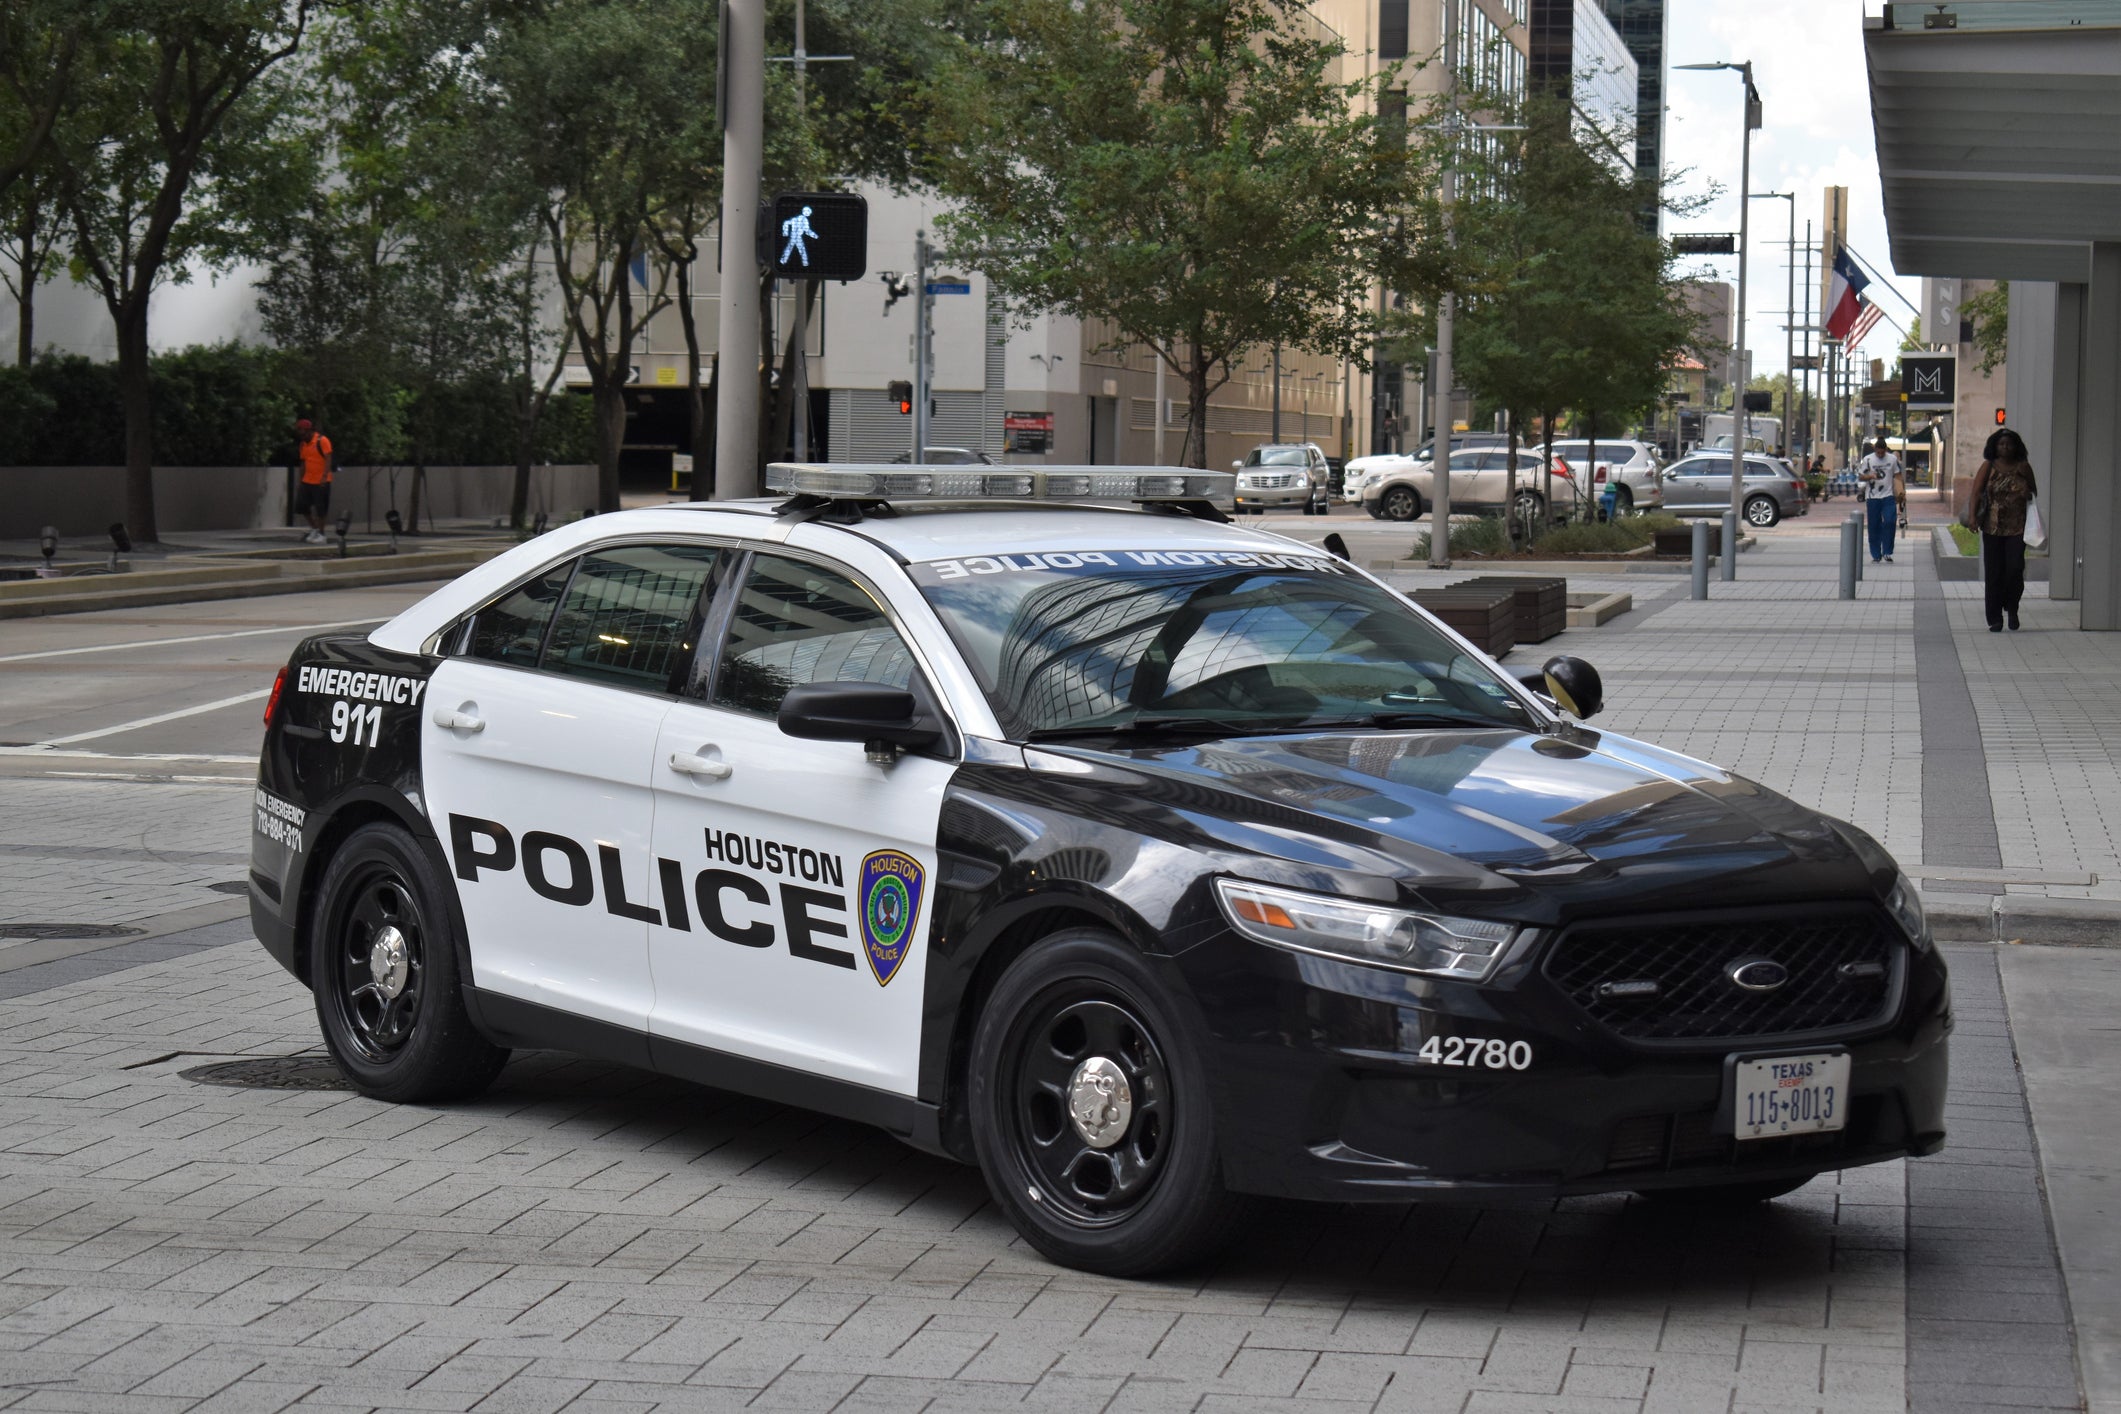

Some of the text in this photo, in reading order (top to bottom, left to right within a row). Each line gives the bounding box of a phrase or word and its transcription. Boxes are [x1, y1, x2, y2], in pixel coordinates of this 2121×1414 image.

[1914, 367, 1941, 392] M
[298, 666, 427, 707] EMERGENCY
[330, 700, 383, 748] 911
[267, 794, 306, 827] EMERGENCY
[704, 827, 844, 888] HOUSTON
[870, 857, 918, 884] HOUSTON
[448, 812, 857, 971] POLICE
[870, 942, 899, 961] POLICE
[1418, 1035, 1533, 1071] 42780
[1771, 1062, 1814, 1079] TEXAS
